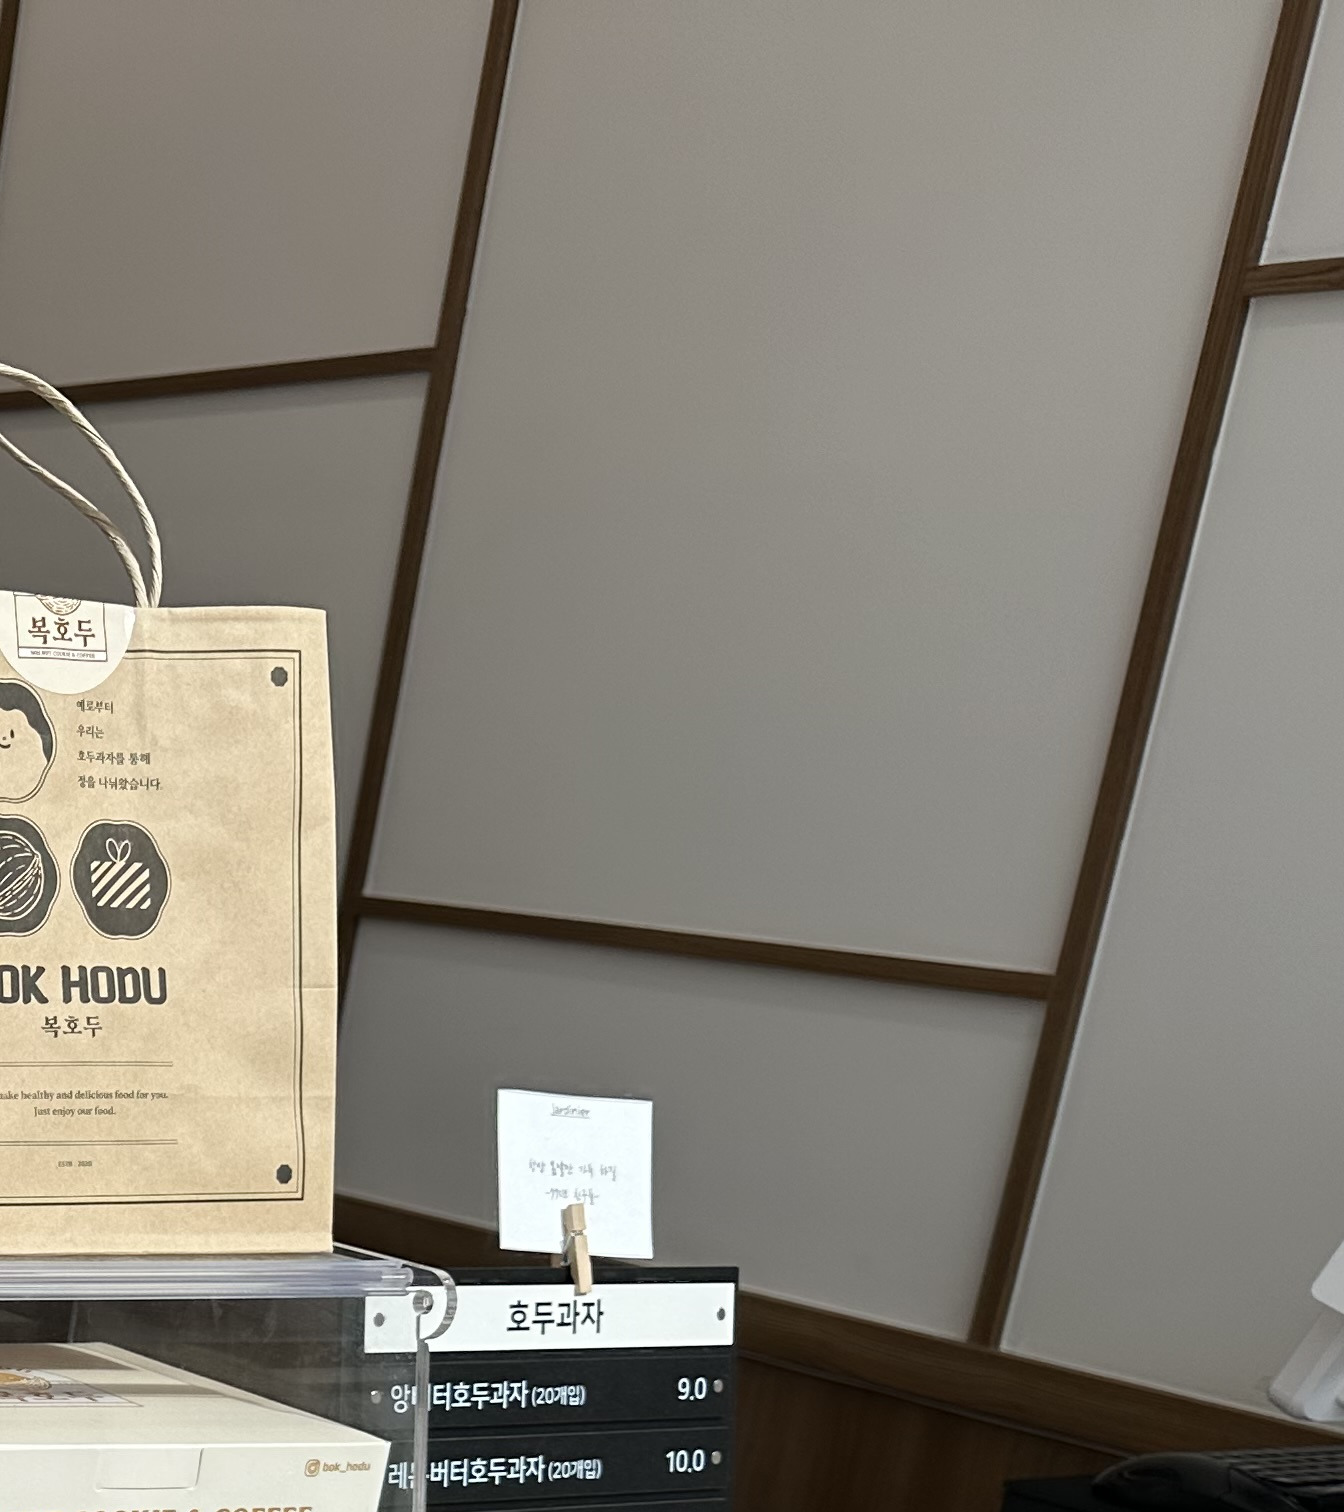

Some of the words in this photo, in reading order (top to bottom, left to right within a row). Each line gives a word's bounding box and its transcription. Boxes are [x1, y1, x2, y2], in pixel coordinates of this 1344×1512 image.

[27, 616, 96, 648] 복호두
[76, 699, 114, 714] 예로부터
[76, 724, 104, 739] 우리는
[77, 750, 125, 765] 호두과자를
[128, 752, 151, 765] 통해
[78, 774, 96, 788] 정을
[61, 966, 168, 1005] HODU
[41, 1015, 103, 1038] 복호두
[21, 1089, 55, 1101] healthy
[56, 1089, 72, 1100] and
[74, 1089, 113, 1100] delicious
[114, 1089, 135, 1100] food
[136, 1089, 149, 1099] for
[150, 1091, 169, 1101] you.
[34, 1106, 51, 1117] Just
[52, 1106, 75, 1117] enjoy
[77, 1107, 92, 1116] our
[94, 1106, 116, 1116] food.
[506, 1297, 605, 1334] 호두과자
[531, 1385, 587, 1408] (20개입)
[677, 1377, 708, 1401] 9.0
[322, 1461, 371, 1473] bok_hodu
[387, 1455, 547, 1490] 레버터호두과자
[548, 1458, 603, 1483] (20개입)
[665, 1449, 707, 1473] 10.0
